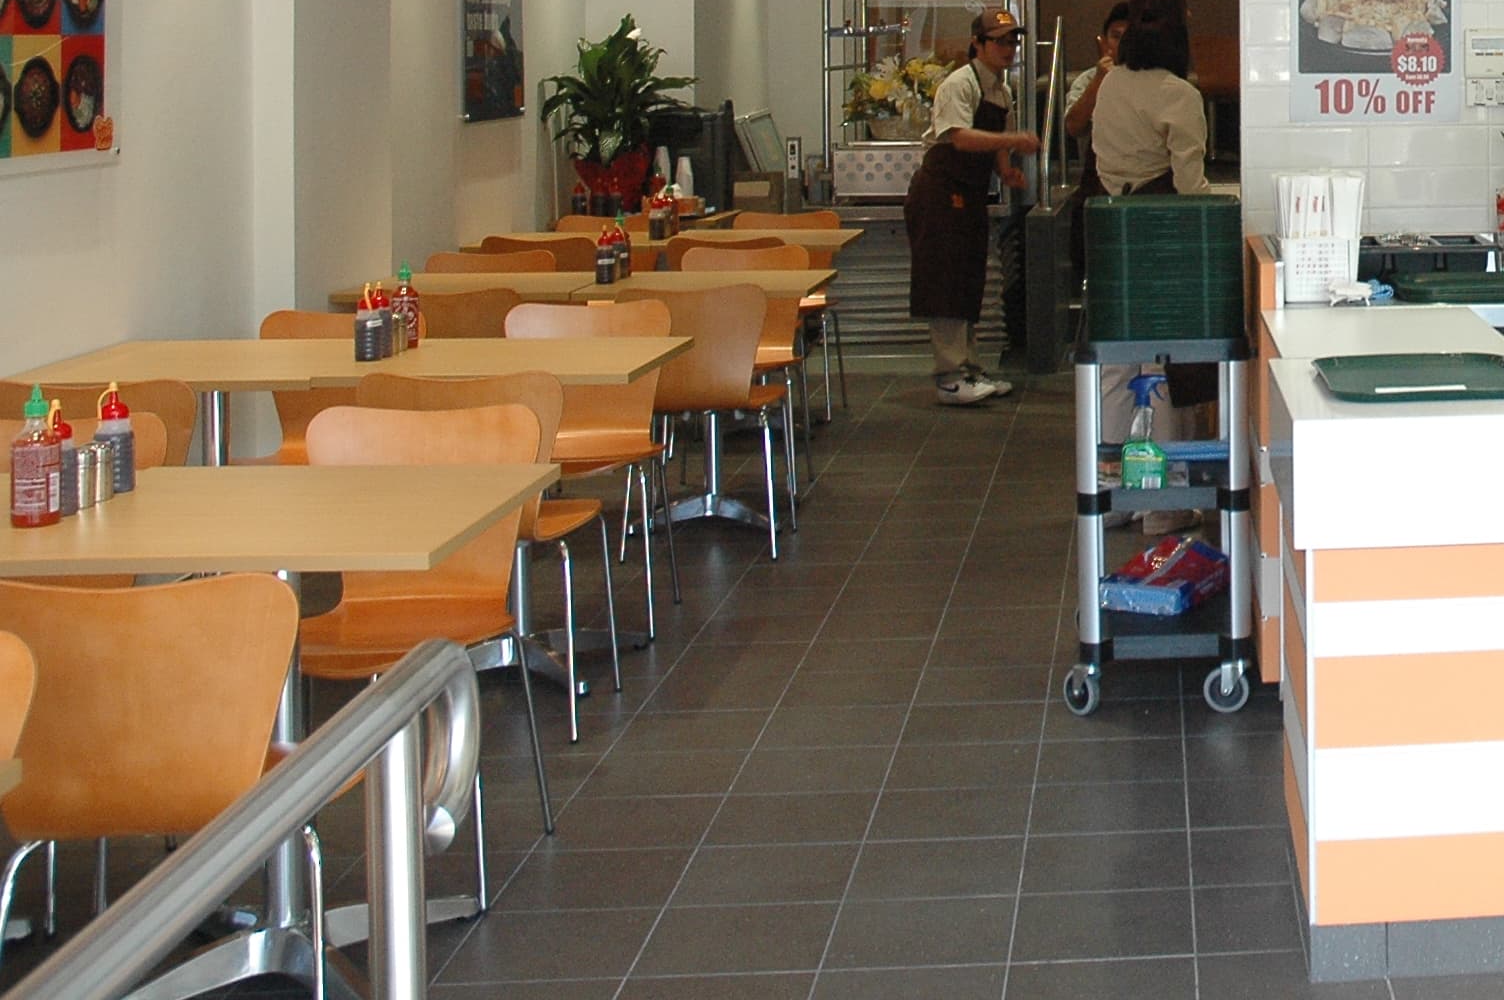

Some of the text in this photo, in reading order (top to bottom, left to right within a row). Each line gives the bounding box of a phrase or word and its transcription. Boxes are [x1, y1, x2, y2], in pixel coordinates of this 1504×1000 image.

[1397, 55, 1437, 73] $8.10
[1314, 78, 1436, 115] 10% OFF
